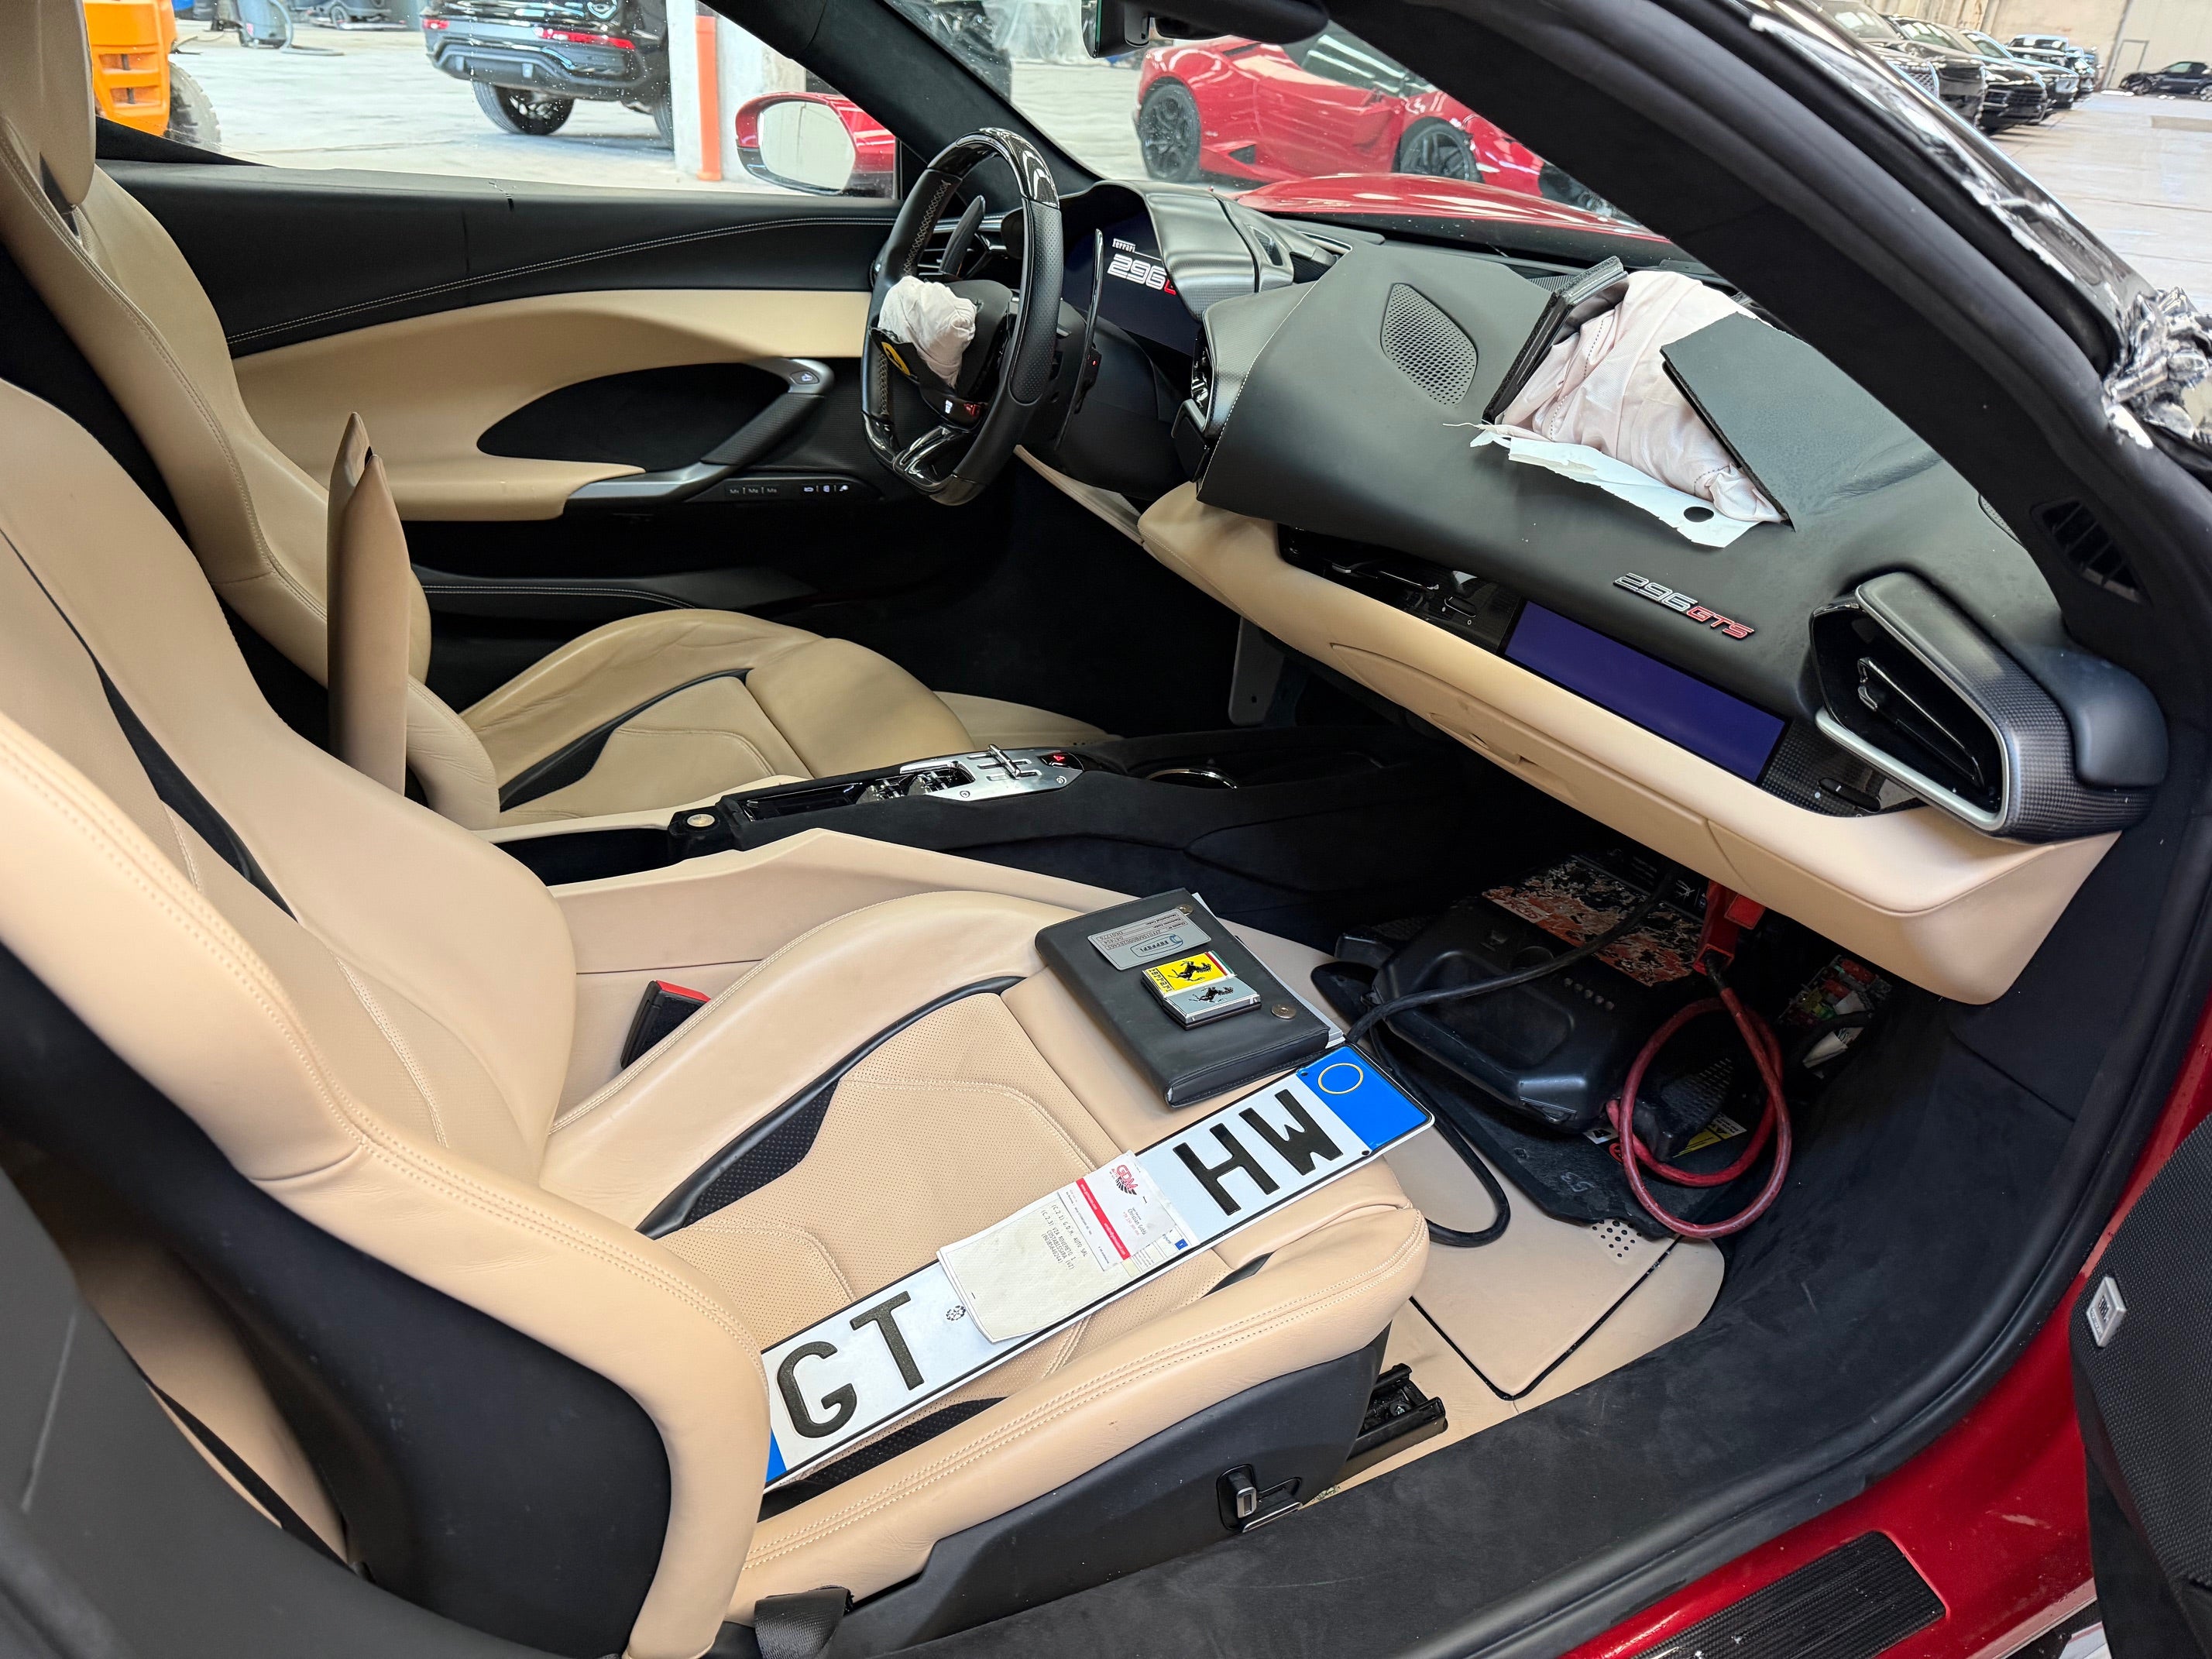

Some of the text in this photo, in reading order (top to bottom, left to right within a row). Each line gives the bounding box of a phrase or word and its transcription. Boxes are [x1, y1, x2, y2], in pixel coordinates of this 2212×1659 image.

[1112, 238, 1136, 252] Ferrari
[1614, 572, 1755, 640] 296GTS
[1139, 939, 1169, 953] Ferrari
[1149, 967, 1173, 994] Ferrari
[1051, 1226, 1060, 1236] VIA
[1072, 1235, 1083, 1248] AUTO
[1080, 1247, 1089, 1258] SRL
[777, 1088, 1344, 1438] GT HW
